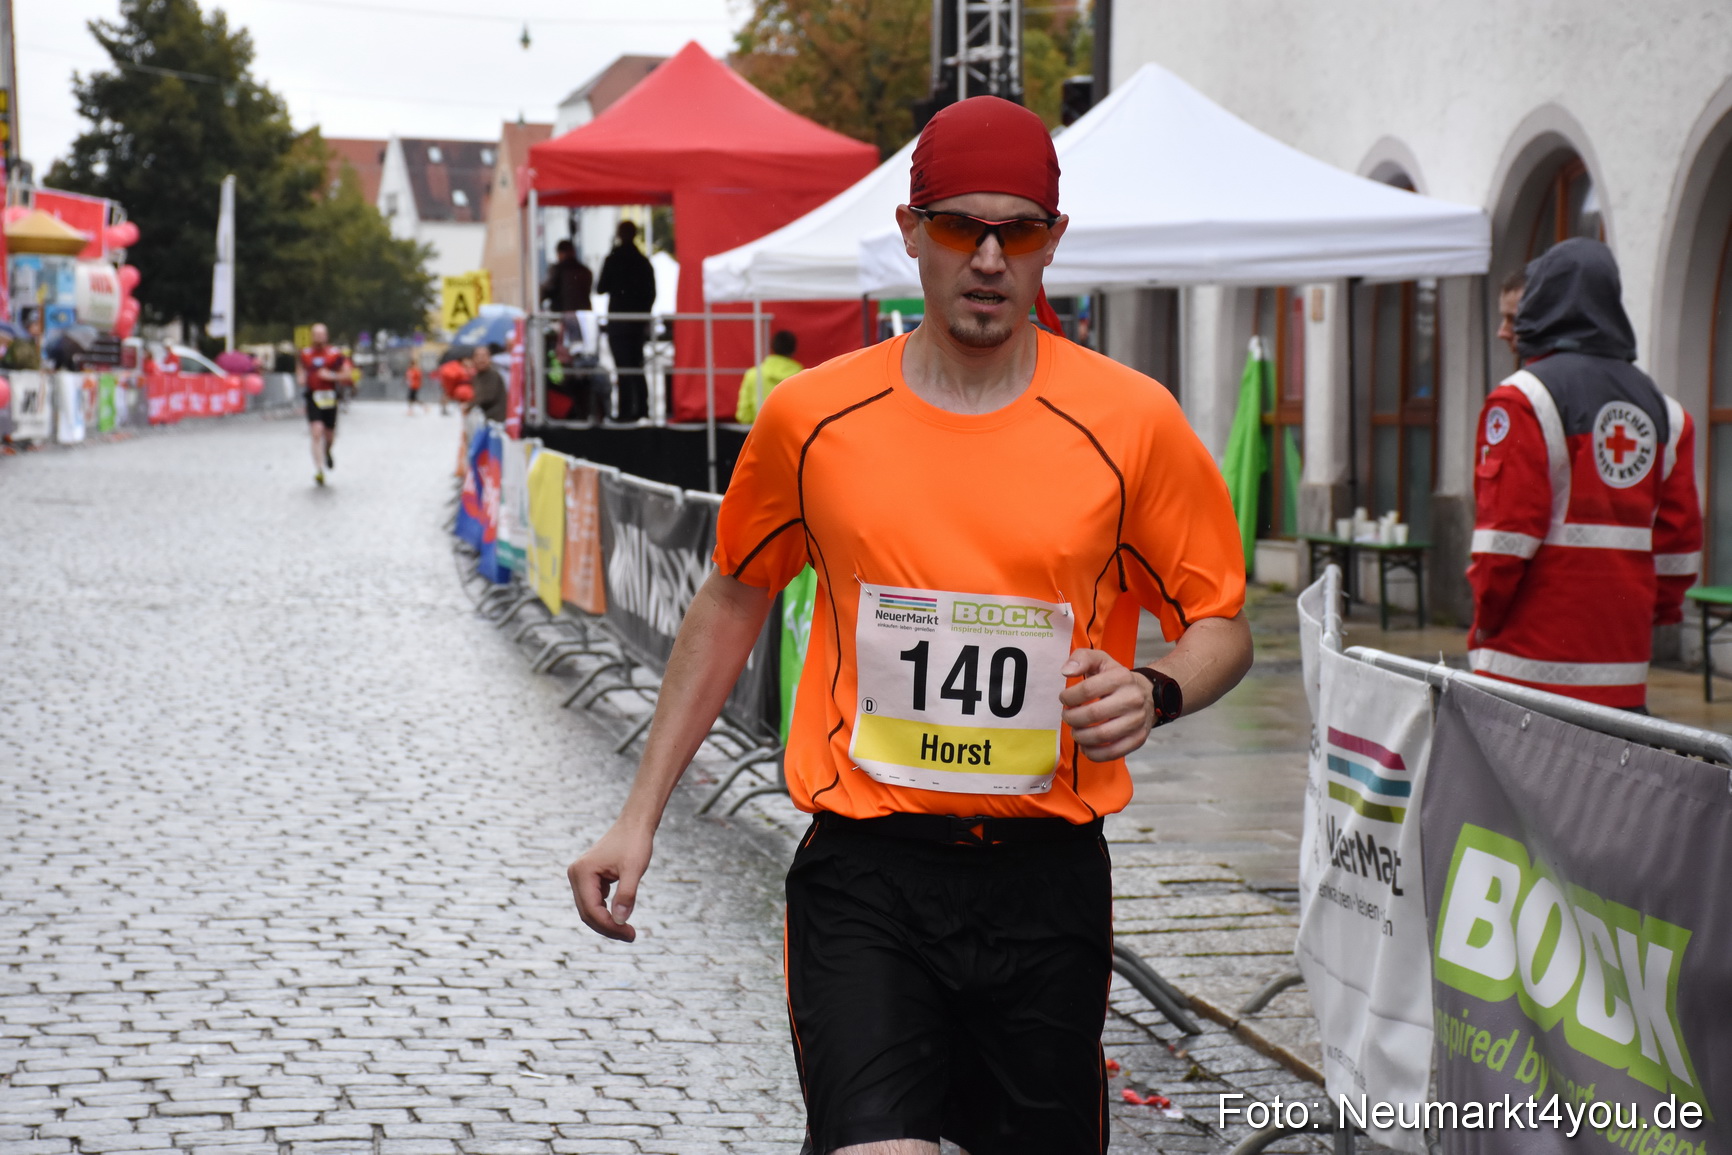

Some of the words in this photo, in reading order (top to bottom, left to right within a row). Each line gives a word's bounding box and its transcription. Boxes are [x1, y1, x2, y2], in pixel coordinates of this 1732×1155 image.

[451, 292, 471, 319] A
[1618, 446, 1651, 479] KREUZ
[875, 609, 939, 626] NeuerMarkt
[953, 602, 1052, 628] BOCK
[951, 625, 982, 634] inspired
[984, 627, 994, 636] by
[996, 628, 1018, 636] smart
[1020, 629, 1054, 638] concepts
[900, 640, 1028, 718] 140
[865, 699, 873, 712] D
[920, 733, 992, 766] Horst
[1437, 840, 1700, 1098] BOCK
[1514, 1035, 1549, 1101] by
